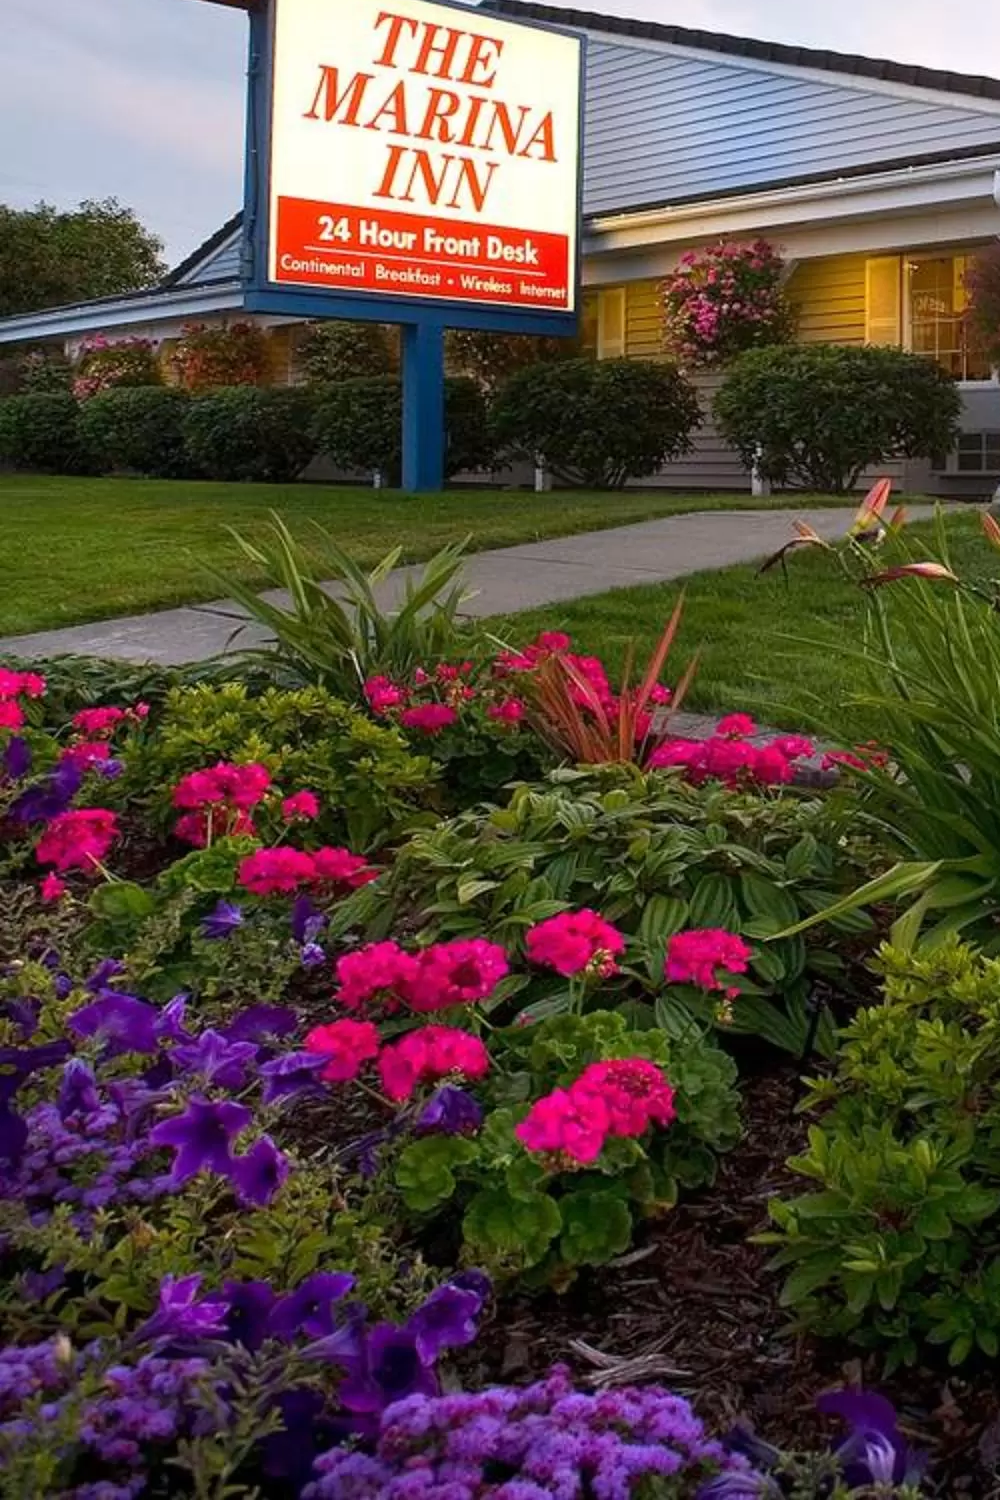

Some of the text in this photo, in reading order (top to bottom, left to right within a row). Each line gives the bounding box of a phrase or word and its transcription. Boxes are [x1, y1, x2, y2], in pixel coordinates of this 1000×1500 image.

[373, 10, 505, 89] THE
[302, 65, 559, 162] MARINA
[372, 144, 500, 213] INN
[318, 215, 539, 265] 24 Hour Front Desk
[281, 253, 567, 299] Continental Breakfast Wireless Internet
